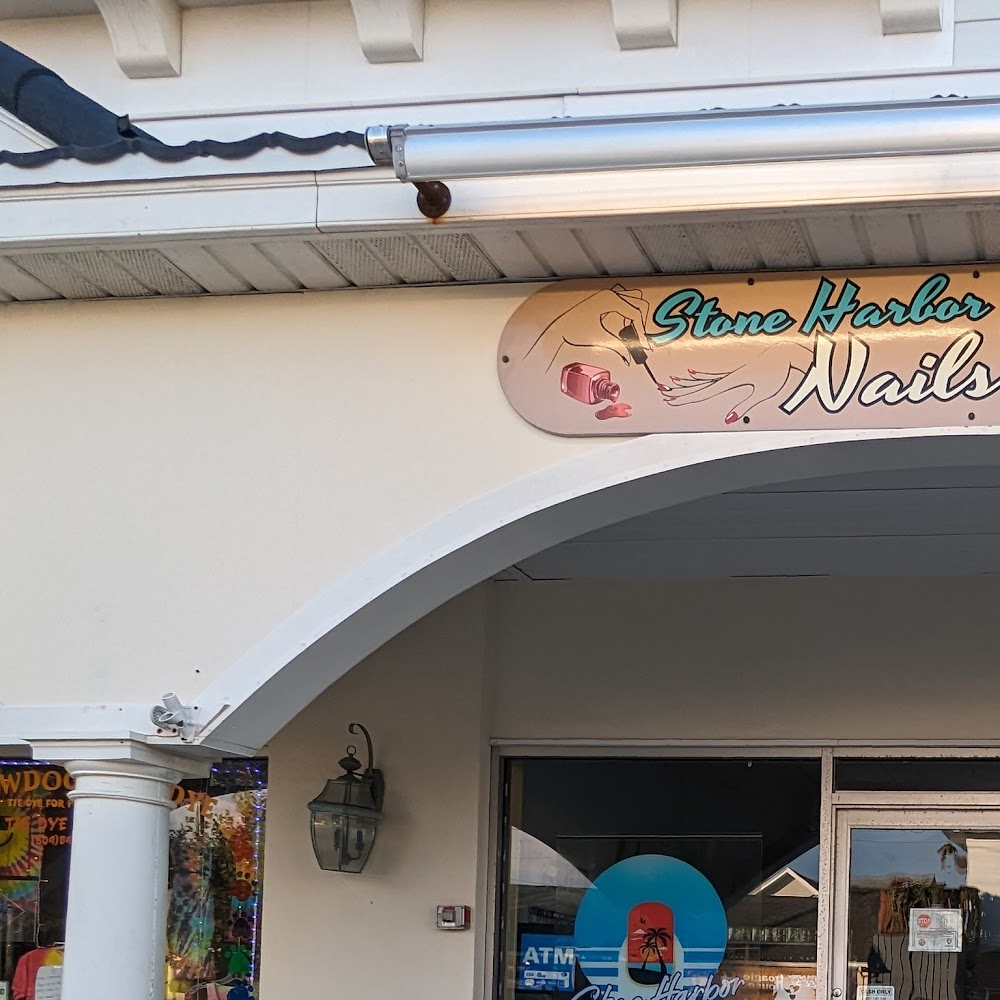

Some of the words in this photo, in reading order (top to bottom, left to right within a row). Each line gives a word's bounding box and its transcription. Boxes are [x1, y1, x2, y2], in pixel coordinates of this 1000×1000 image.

[648, 287, 797, 344] Stone
[799, 272, 996, 336] Harbor
[46, 798, 65, 808] FOR
[522, 946, 575, 965] ATM
